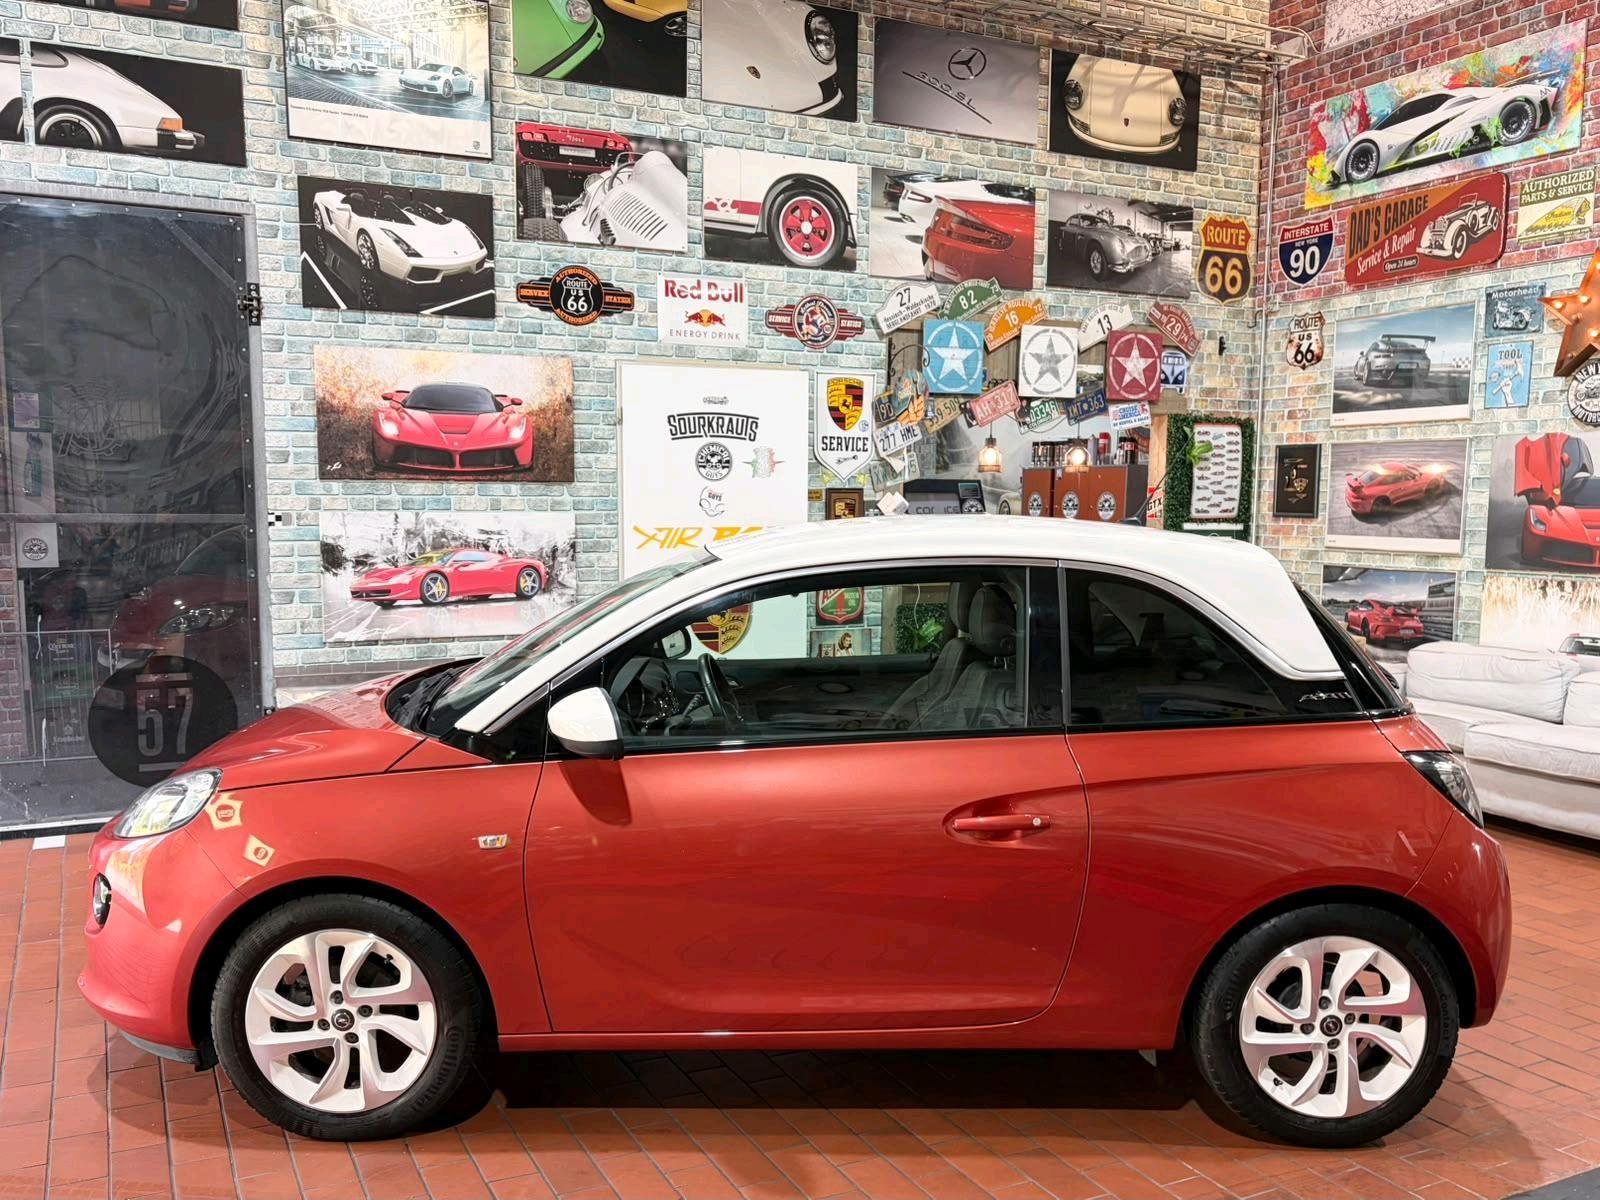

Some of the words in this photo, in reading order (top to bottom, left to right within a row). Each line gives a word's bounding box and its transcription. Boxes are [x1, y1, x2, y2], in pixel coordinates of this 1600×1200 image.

[1521, 190, 1547, 204] PARTS
[1548, 188, 1556, 199] &
[1557, 180, 1593, 196] SERVICE
[1522, 169, 1595, 194] AUTHORIZED
[1206, 225, 1246, 246] ROUTE
[1284, 222, 1329, 240] INTERSTATE
[1349, 205, 1381, 259] DAD'S
[1384, 194, 1429, 236] GARAGE
[1357, 248, 1382, 277] Service
[1383, 240, 1390, 259] &
[1391, 224, 1416, 254] Repair
[1289, 245, 1321, 279] 90
[566, 280, 588, 289] ROUTE
[1205, 255, 1244, 296] 66
[570, 288, 584, 296] US
[664, 279, 702, 300] Red
[707, 281, 744, 304] Bull
[896, 287, 911, 308] 27
[959, 289, 978, 310] 82
[567, 296, 588, 312] 66
[768, 314, 792, 324] SERVICE
[1005, 310, 1019, 328] 16
[1097, 314, 1113, 335] 13
[1166, 317, 1182, 336] 29
[1293, 316, 1320, 330] ROUTE
[669, 328, 708, 339] ENERGY
[711, 331, 741, 341] DRINK
[1297, 331, 1313, 342] US
[1293, 342, 1315, 364] 66
[1499, 348, 1523, 360] TOOL
[1575, 362, 1596, 384] NEW
[667, 412, 759, 442] SOURKRAUTS
[821, 435, 869, 453] SERVICE
[879, 433, 898, 453] 277
[900, 425, 919, 442] HME
[698, 444, 732, 463] CHEMICAL
[705, 468, 724, 479] GUYS
[135, 687, 194, 758] 57
